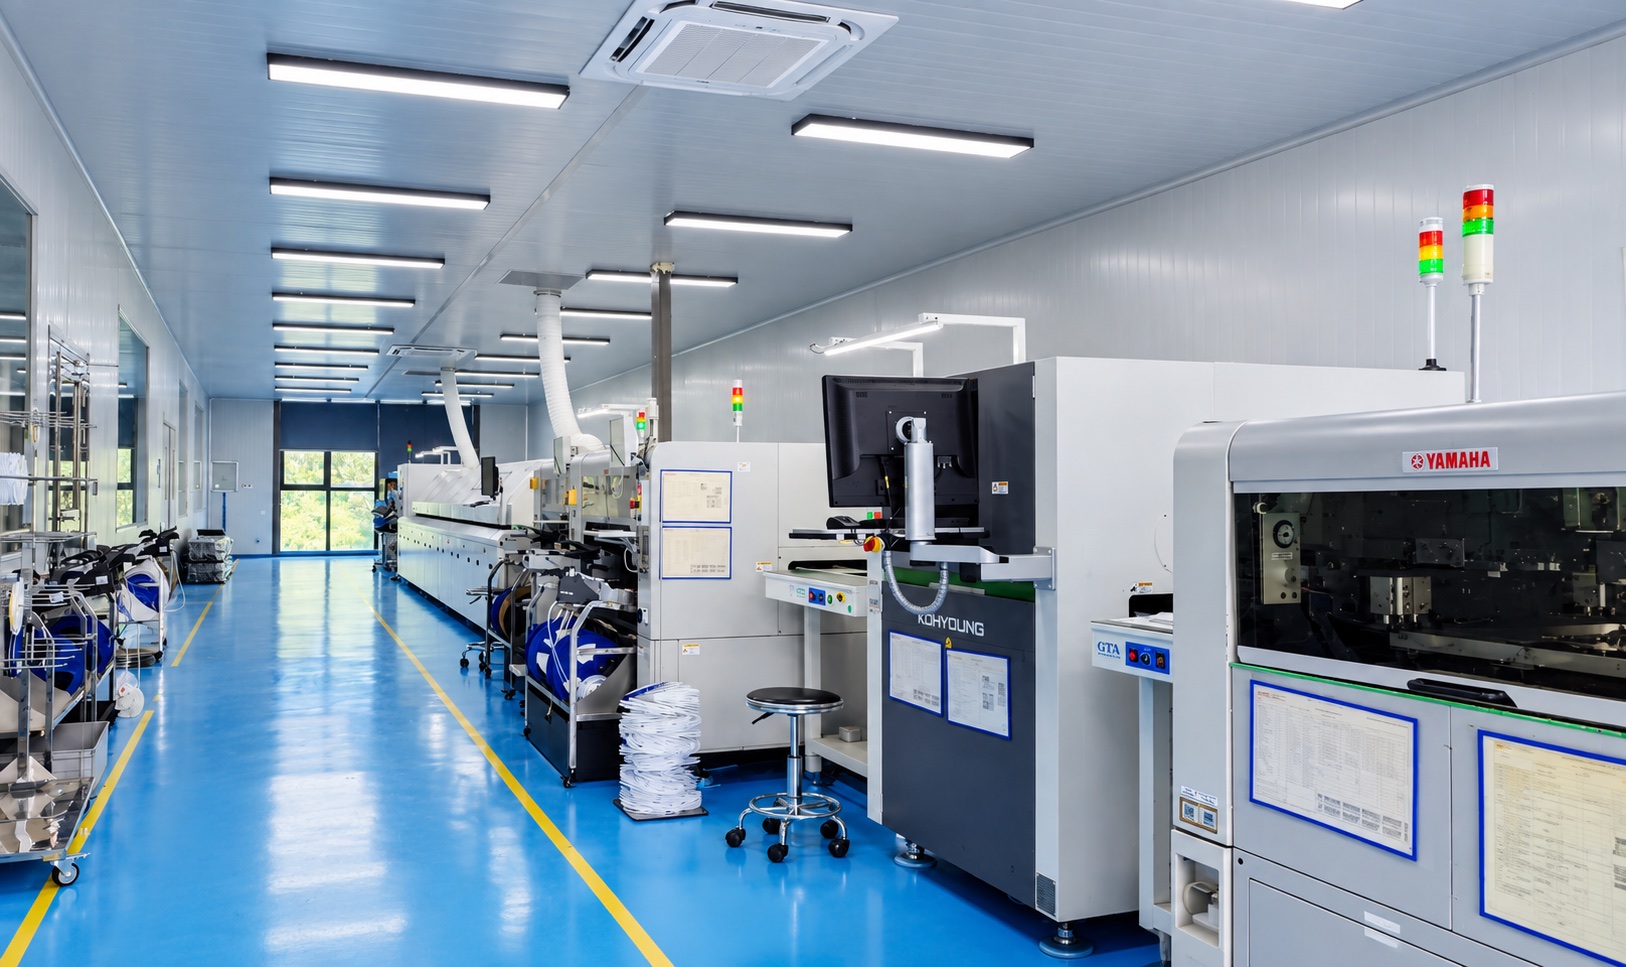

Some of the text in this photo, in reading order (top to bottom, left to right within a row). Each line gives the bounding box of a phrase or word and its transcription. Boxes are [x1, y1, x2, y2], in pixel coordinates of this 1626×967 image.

[1426, 450, 1491, 470] YAMAHA
[917, 613, 985, 637] KOHYOUNG
[1097, 641, 1120, 655] GTA
